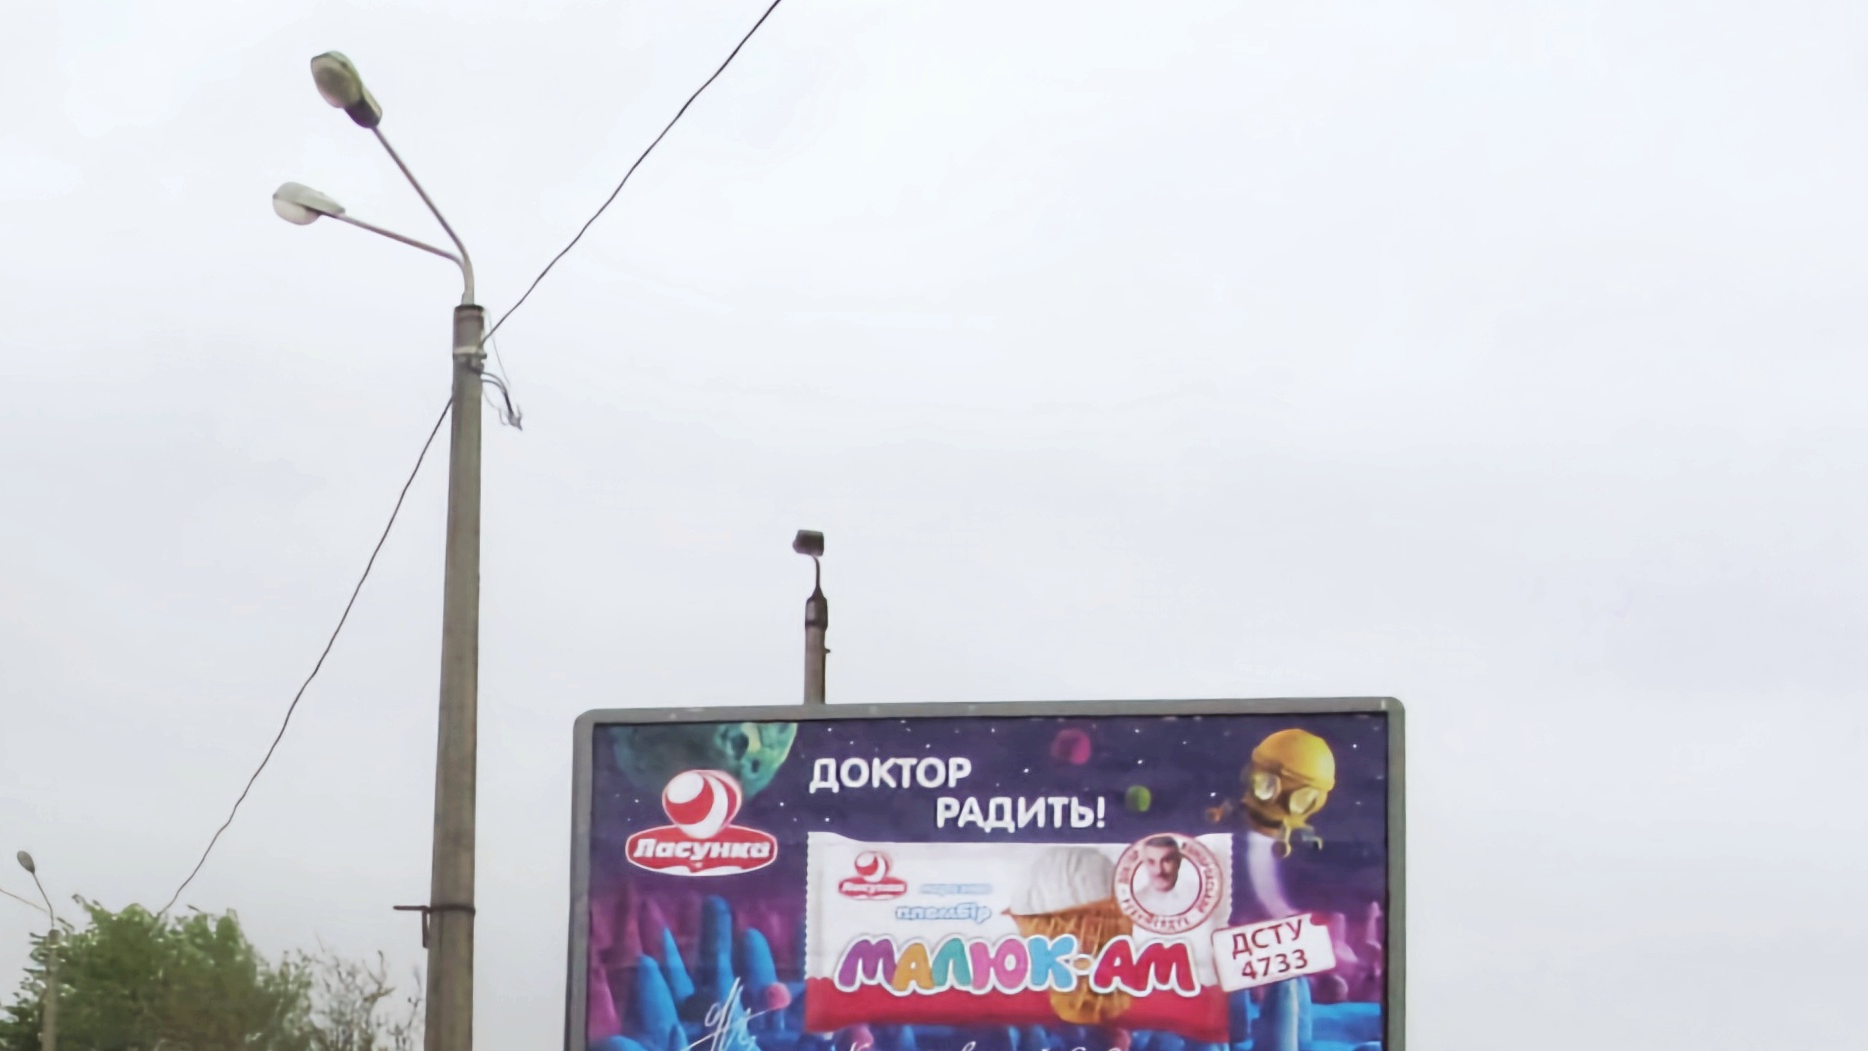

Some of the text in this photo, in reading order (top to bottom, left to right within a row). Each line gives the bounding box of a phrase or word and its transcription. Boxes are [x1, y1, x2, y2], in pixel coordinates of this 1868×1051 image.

[809, 757, 972, 794] ДОКТОР
[936, 796, 1106, 833] РАДИТЬ!
[633, 838, 771, 861] Ласунка
[1232, 918, 1302, 960] ДСТУ
[1241, 949, 1308, 980] 4733
